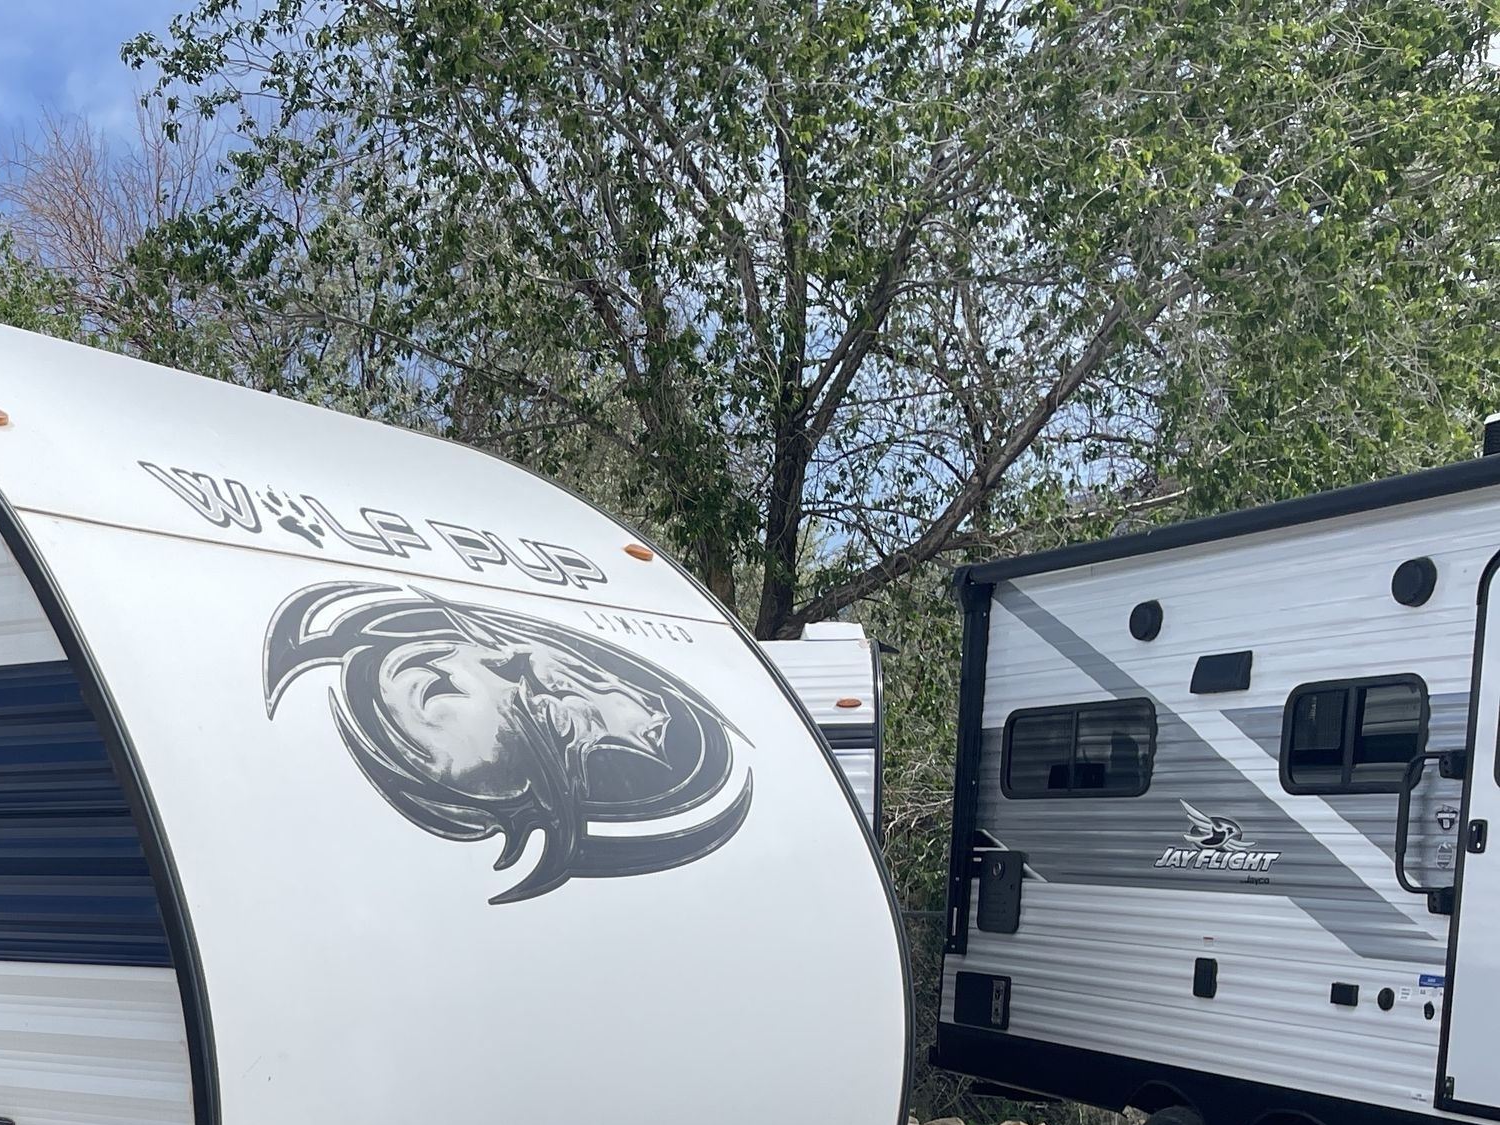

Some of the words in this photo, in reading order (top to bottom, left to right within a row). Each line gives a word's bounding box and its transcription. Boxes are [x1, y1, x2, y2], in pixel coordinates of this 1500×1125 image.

[426, 518, 608, 590] PUP
[583, 610, 694, 643] LIMITED
[1154, 846, 1198, 868] JAY
[1193, 848, 1281, 872] FLIGHT
